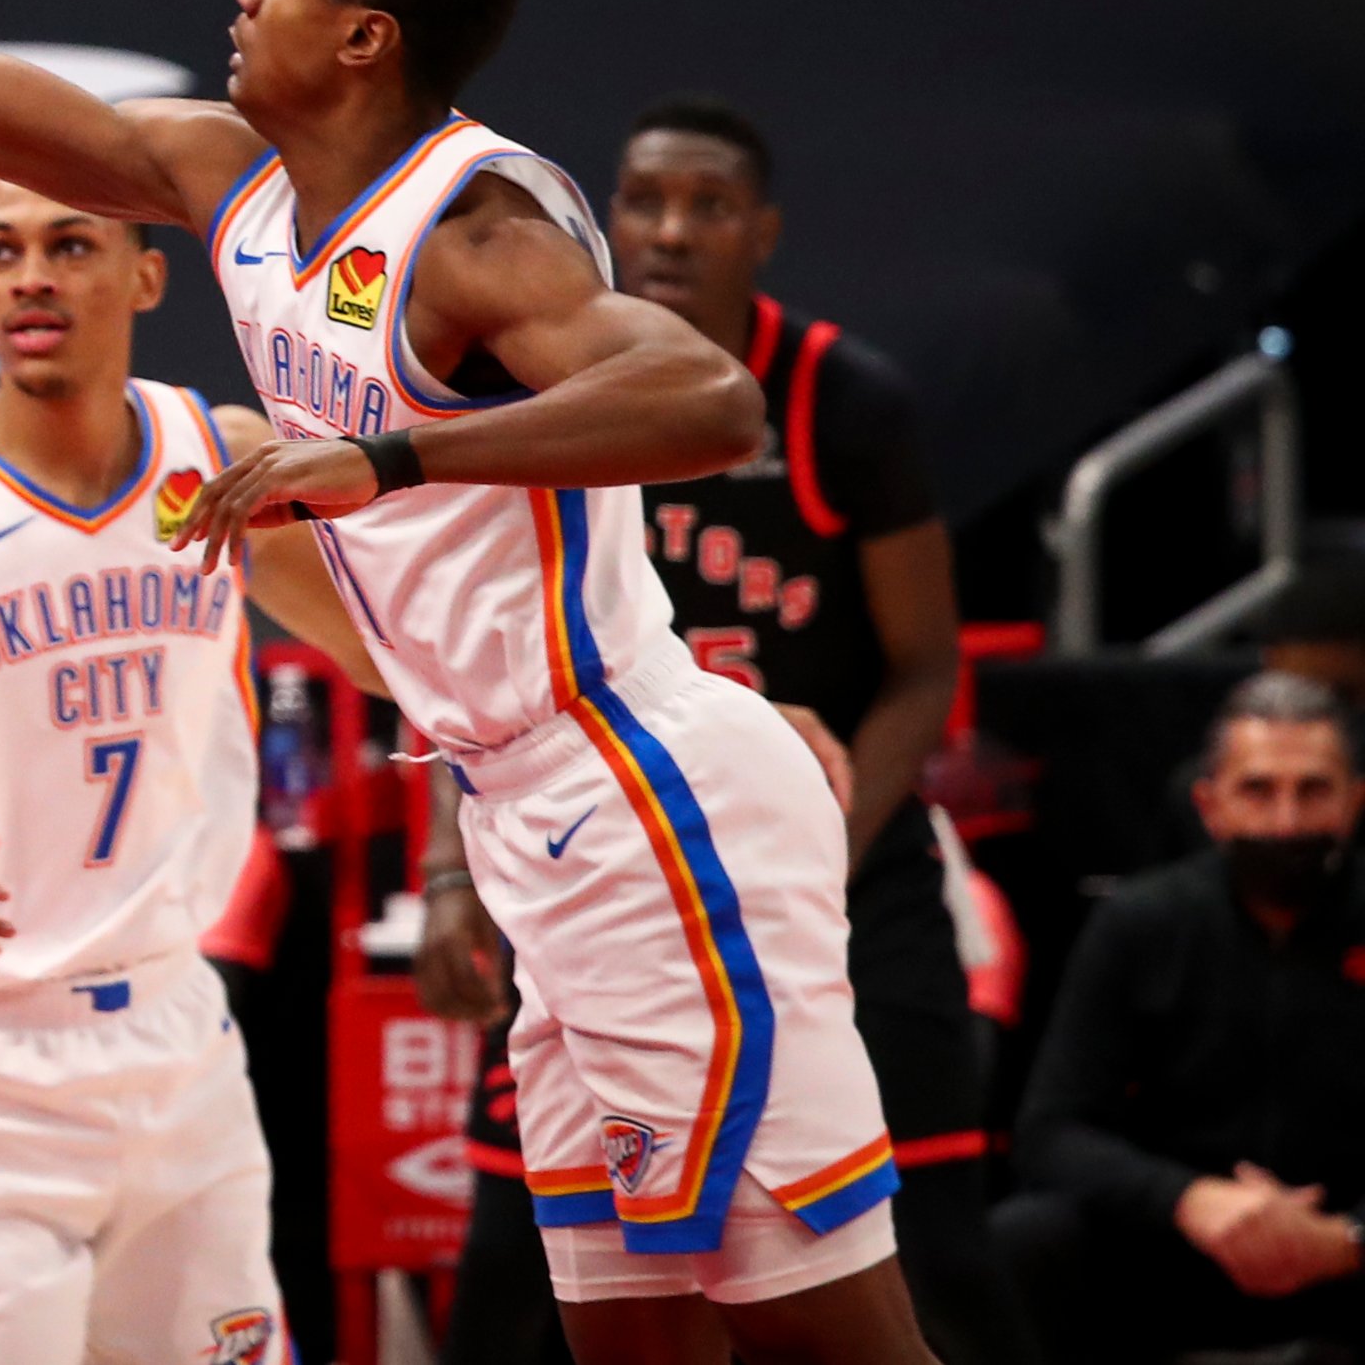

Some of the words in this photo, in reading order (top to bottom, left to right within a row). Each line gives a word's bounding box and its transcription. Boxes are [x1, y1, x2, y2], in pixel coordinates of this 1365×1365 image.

[49, 644, 166, 731] CITY
[83, 730, 143, 869] 7
[382, 1016, 478, 1087] BI
